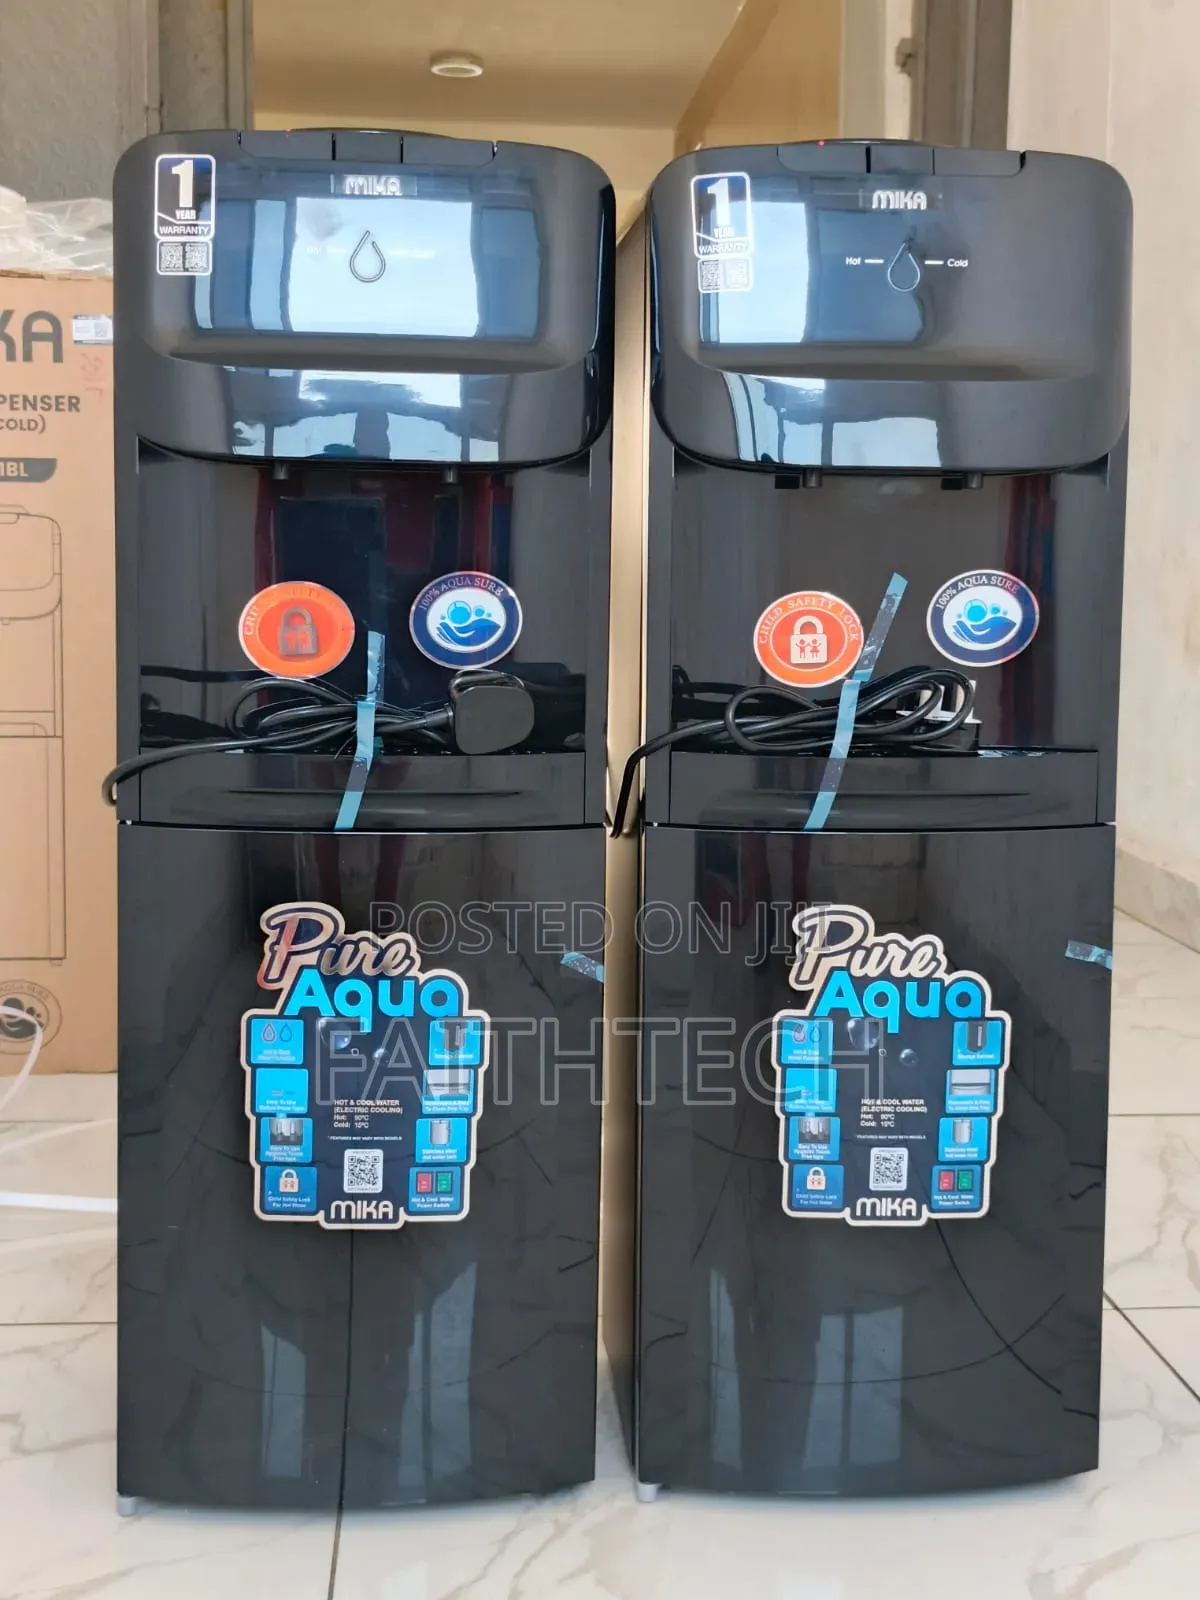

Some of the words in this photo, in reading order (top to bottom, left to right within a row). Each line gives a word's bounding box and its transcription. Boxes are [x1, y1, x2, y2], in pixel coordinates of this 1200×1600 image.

[171, 160, 194, 208] 1
[344, 175, 402, 196] MIKA
[872, 190, 927, 210] MIKA
[175, 209, 197, 220] YEAR
[706, 178, 731, 227] 1
[159, 226, 210, 235] WARRANTY
[845, 257, 862, 265] Hot
[947, 258, 968, 267] Cold
[418, 588, 440, 610] 100%
[441, 577, 472, 592] AQUA
[474, 577, 504, 596] SURE
[936, 587, 957, 610] 100%
[957, 576, 988, 590] AQUA
[990, 576, 1020, 594] SURE
[759, 607, 783, 644] CHILD
[787, 596, 836, 609] SAFETY
[840, 610, 859, 642] LOCK
[262, 905, 416, 984] Pure
[796, 908, 942, 985] Pure
[284, 969, 459, 1032] Aqua
[814, 970, 982, 1033] Aqua
[331, 1200, 394, 1220] MIKA
[856, 1197, 917, 1217] MIKA
